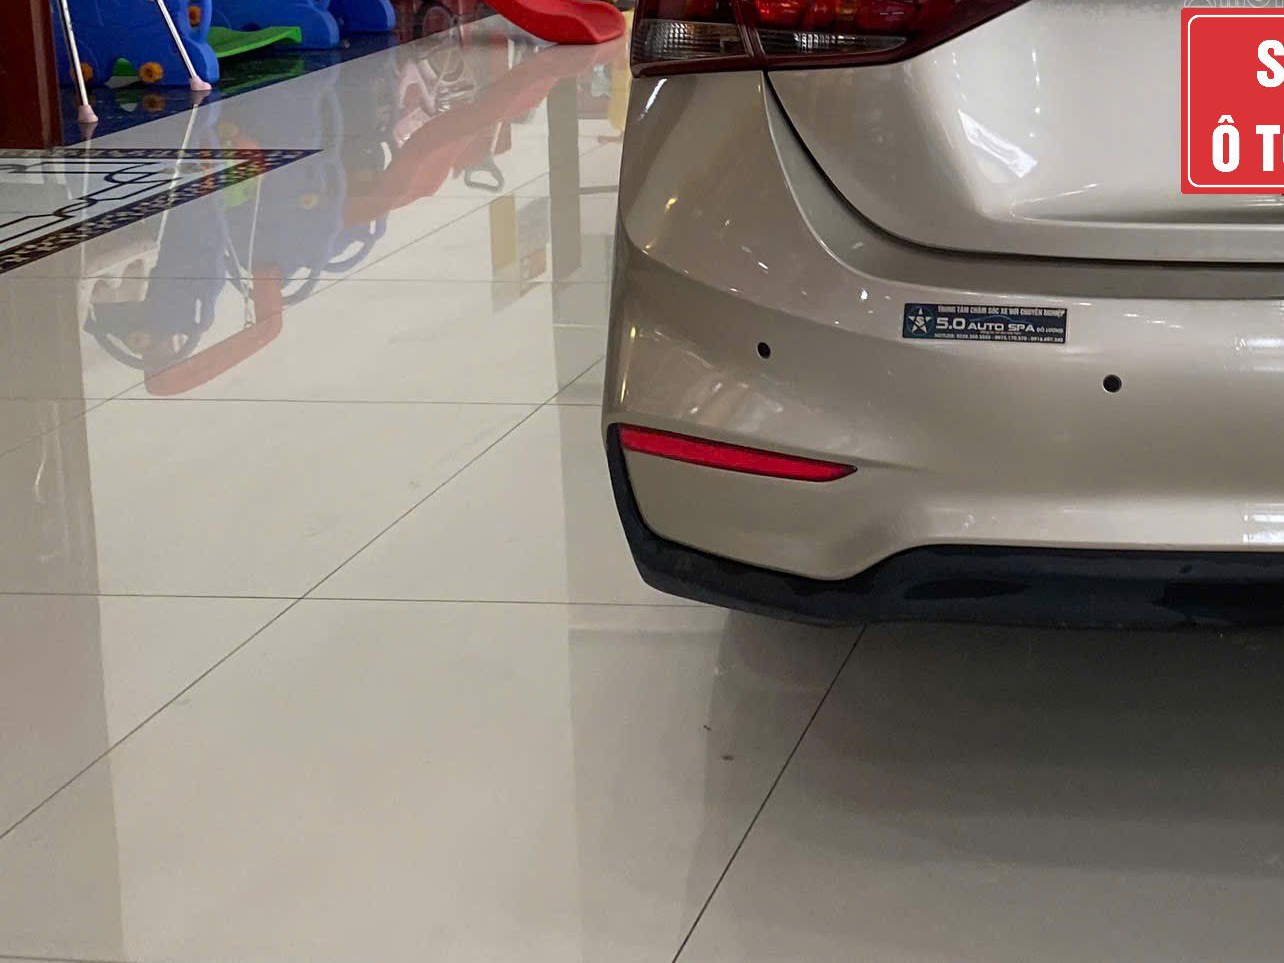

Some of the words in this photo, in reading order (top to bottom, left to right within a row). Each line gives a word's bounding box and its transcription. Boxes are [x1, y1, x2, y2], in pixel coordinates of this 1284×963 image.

[936, 317, 966, 330] 5.0
[968, 322, 1005, 331] AUTO
[1008, 323, 1035, 333] SPA
